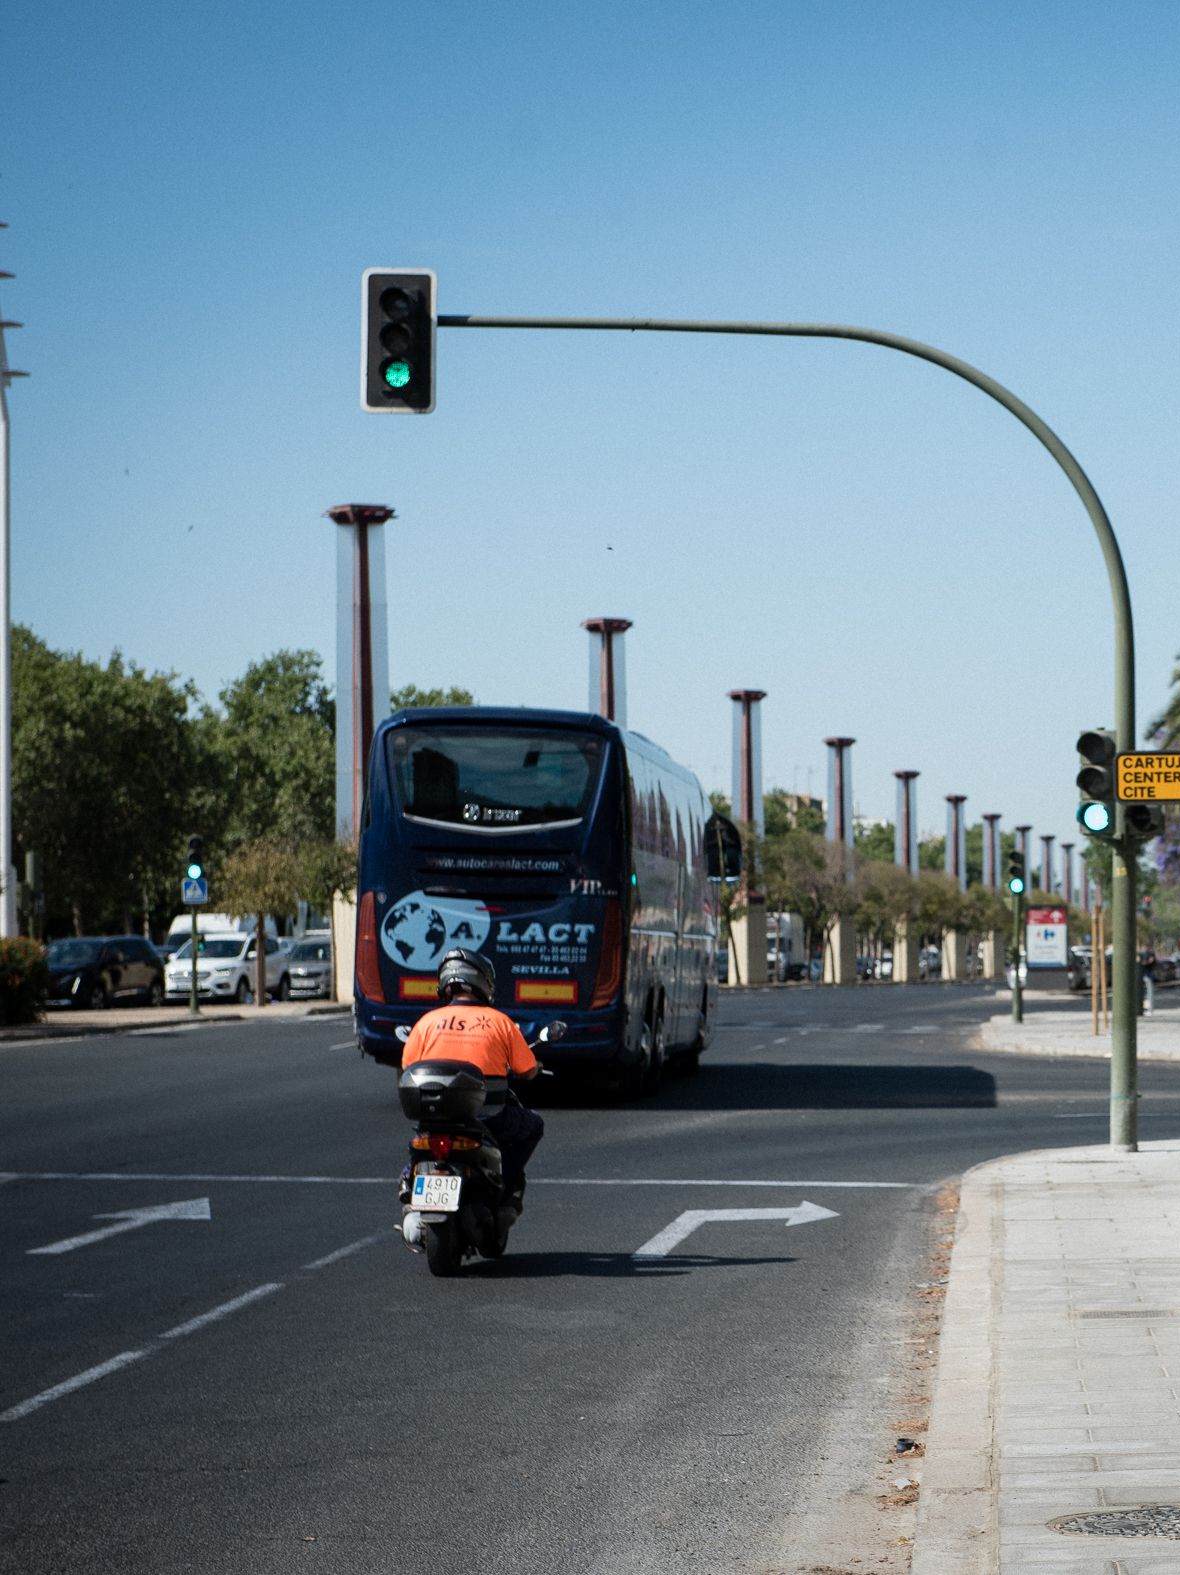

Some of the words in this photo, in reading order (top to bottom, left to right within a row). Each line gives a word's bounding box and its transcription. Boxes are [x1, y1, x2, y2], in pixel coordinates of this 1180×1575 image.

[1123, 786, 1156, 798] CITE
[569, 879, 602, 896] VIP
[449, 922, 483, 941] A.
[496, 922, 595, 944] LACT
[511, 964, 570, 975] SEVILLA
[425, 1191, 449, 1206] GJG
